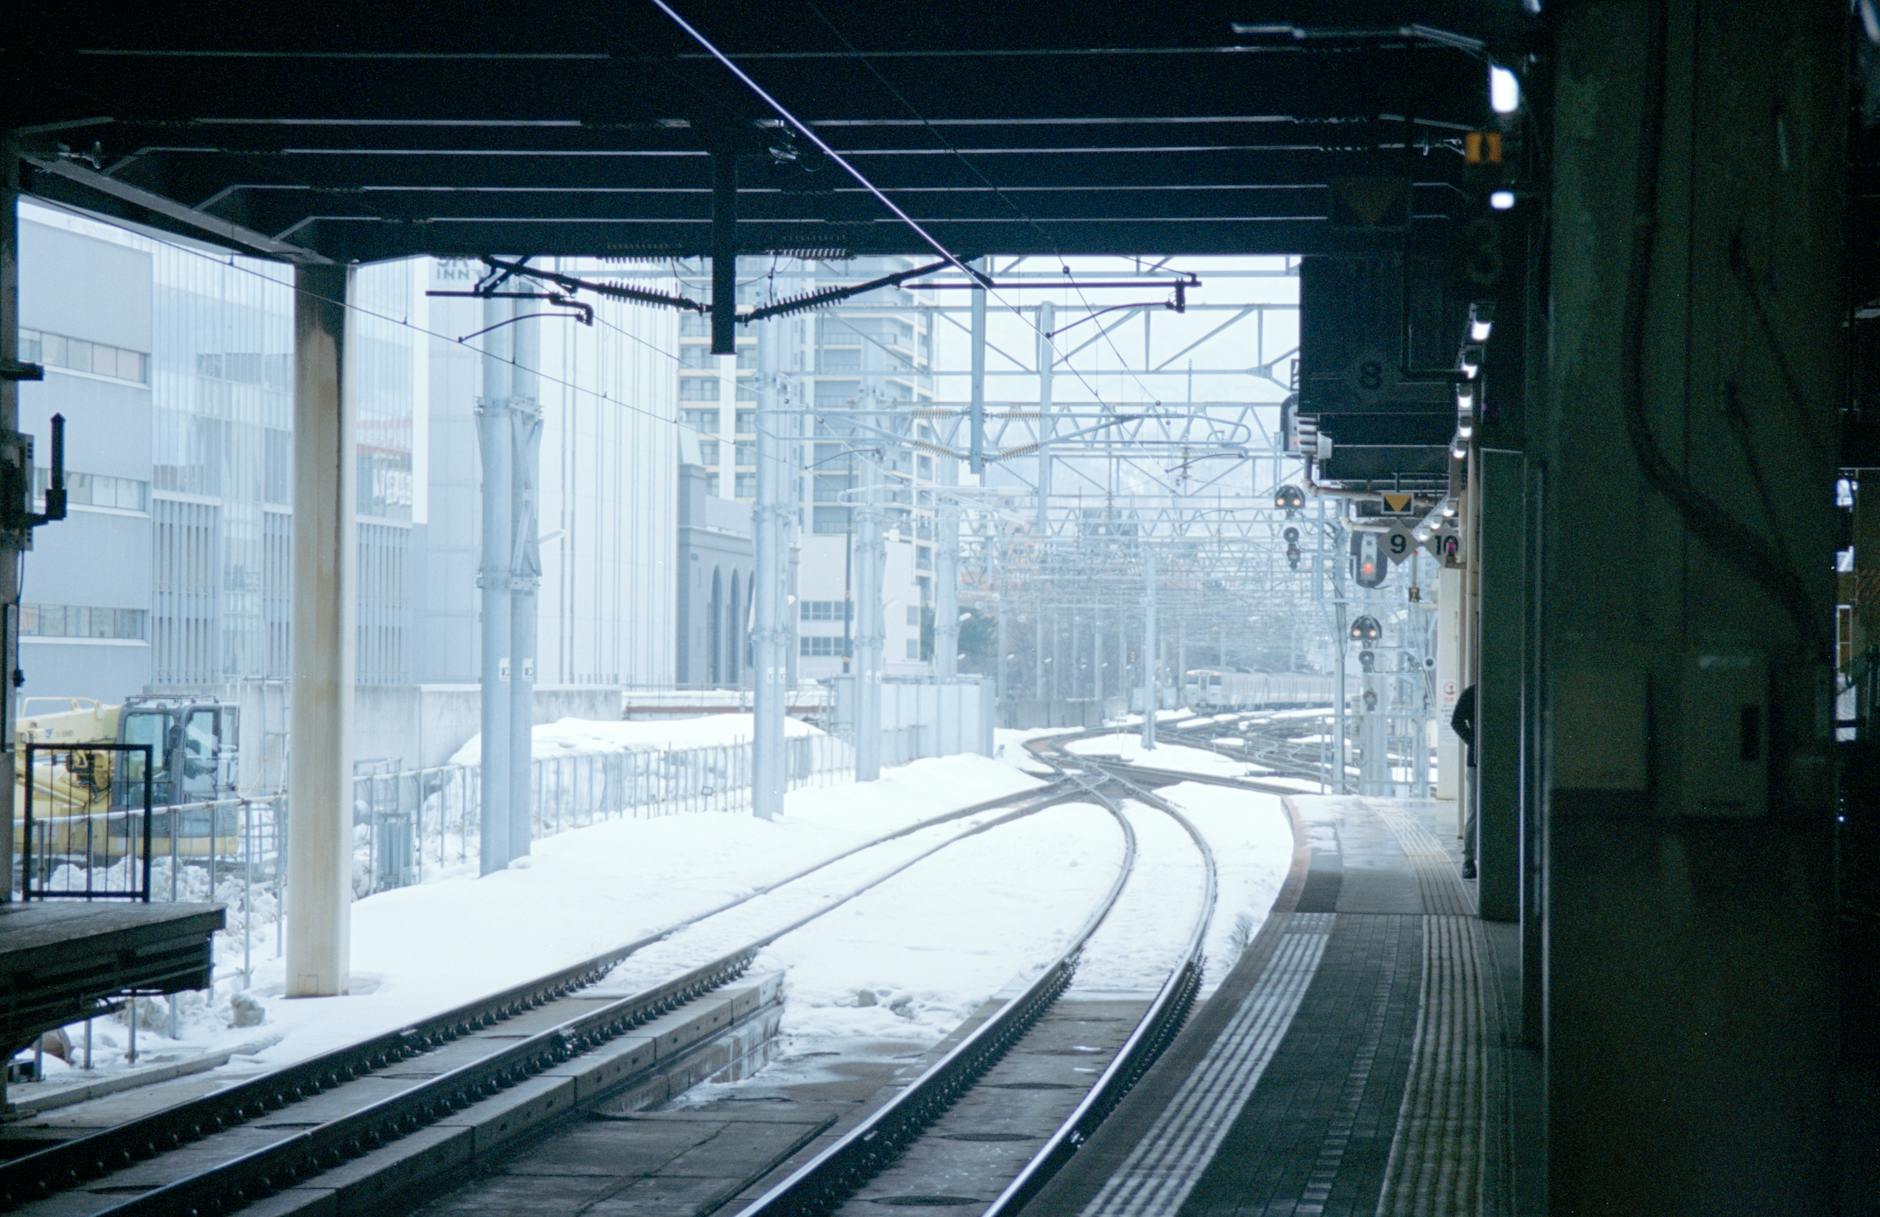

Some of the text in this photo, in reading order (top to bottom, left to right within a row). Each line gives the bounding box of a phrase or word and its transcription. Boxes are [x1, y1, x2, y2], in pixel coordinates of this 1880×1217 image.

[436, 268, 470, 280] INN
[1359, 361, 1382, 390] 8
[1390, 533, 1407, 554] 9
